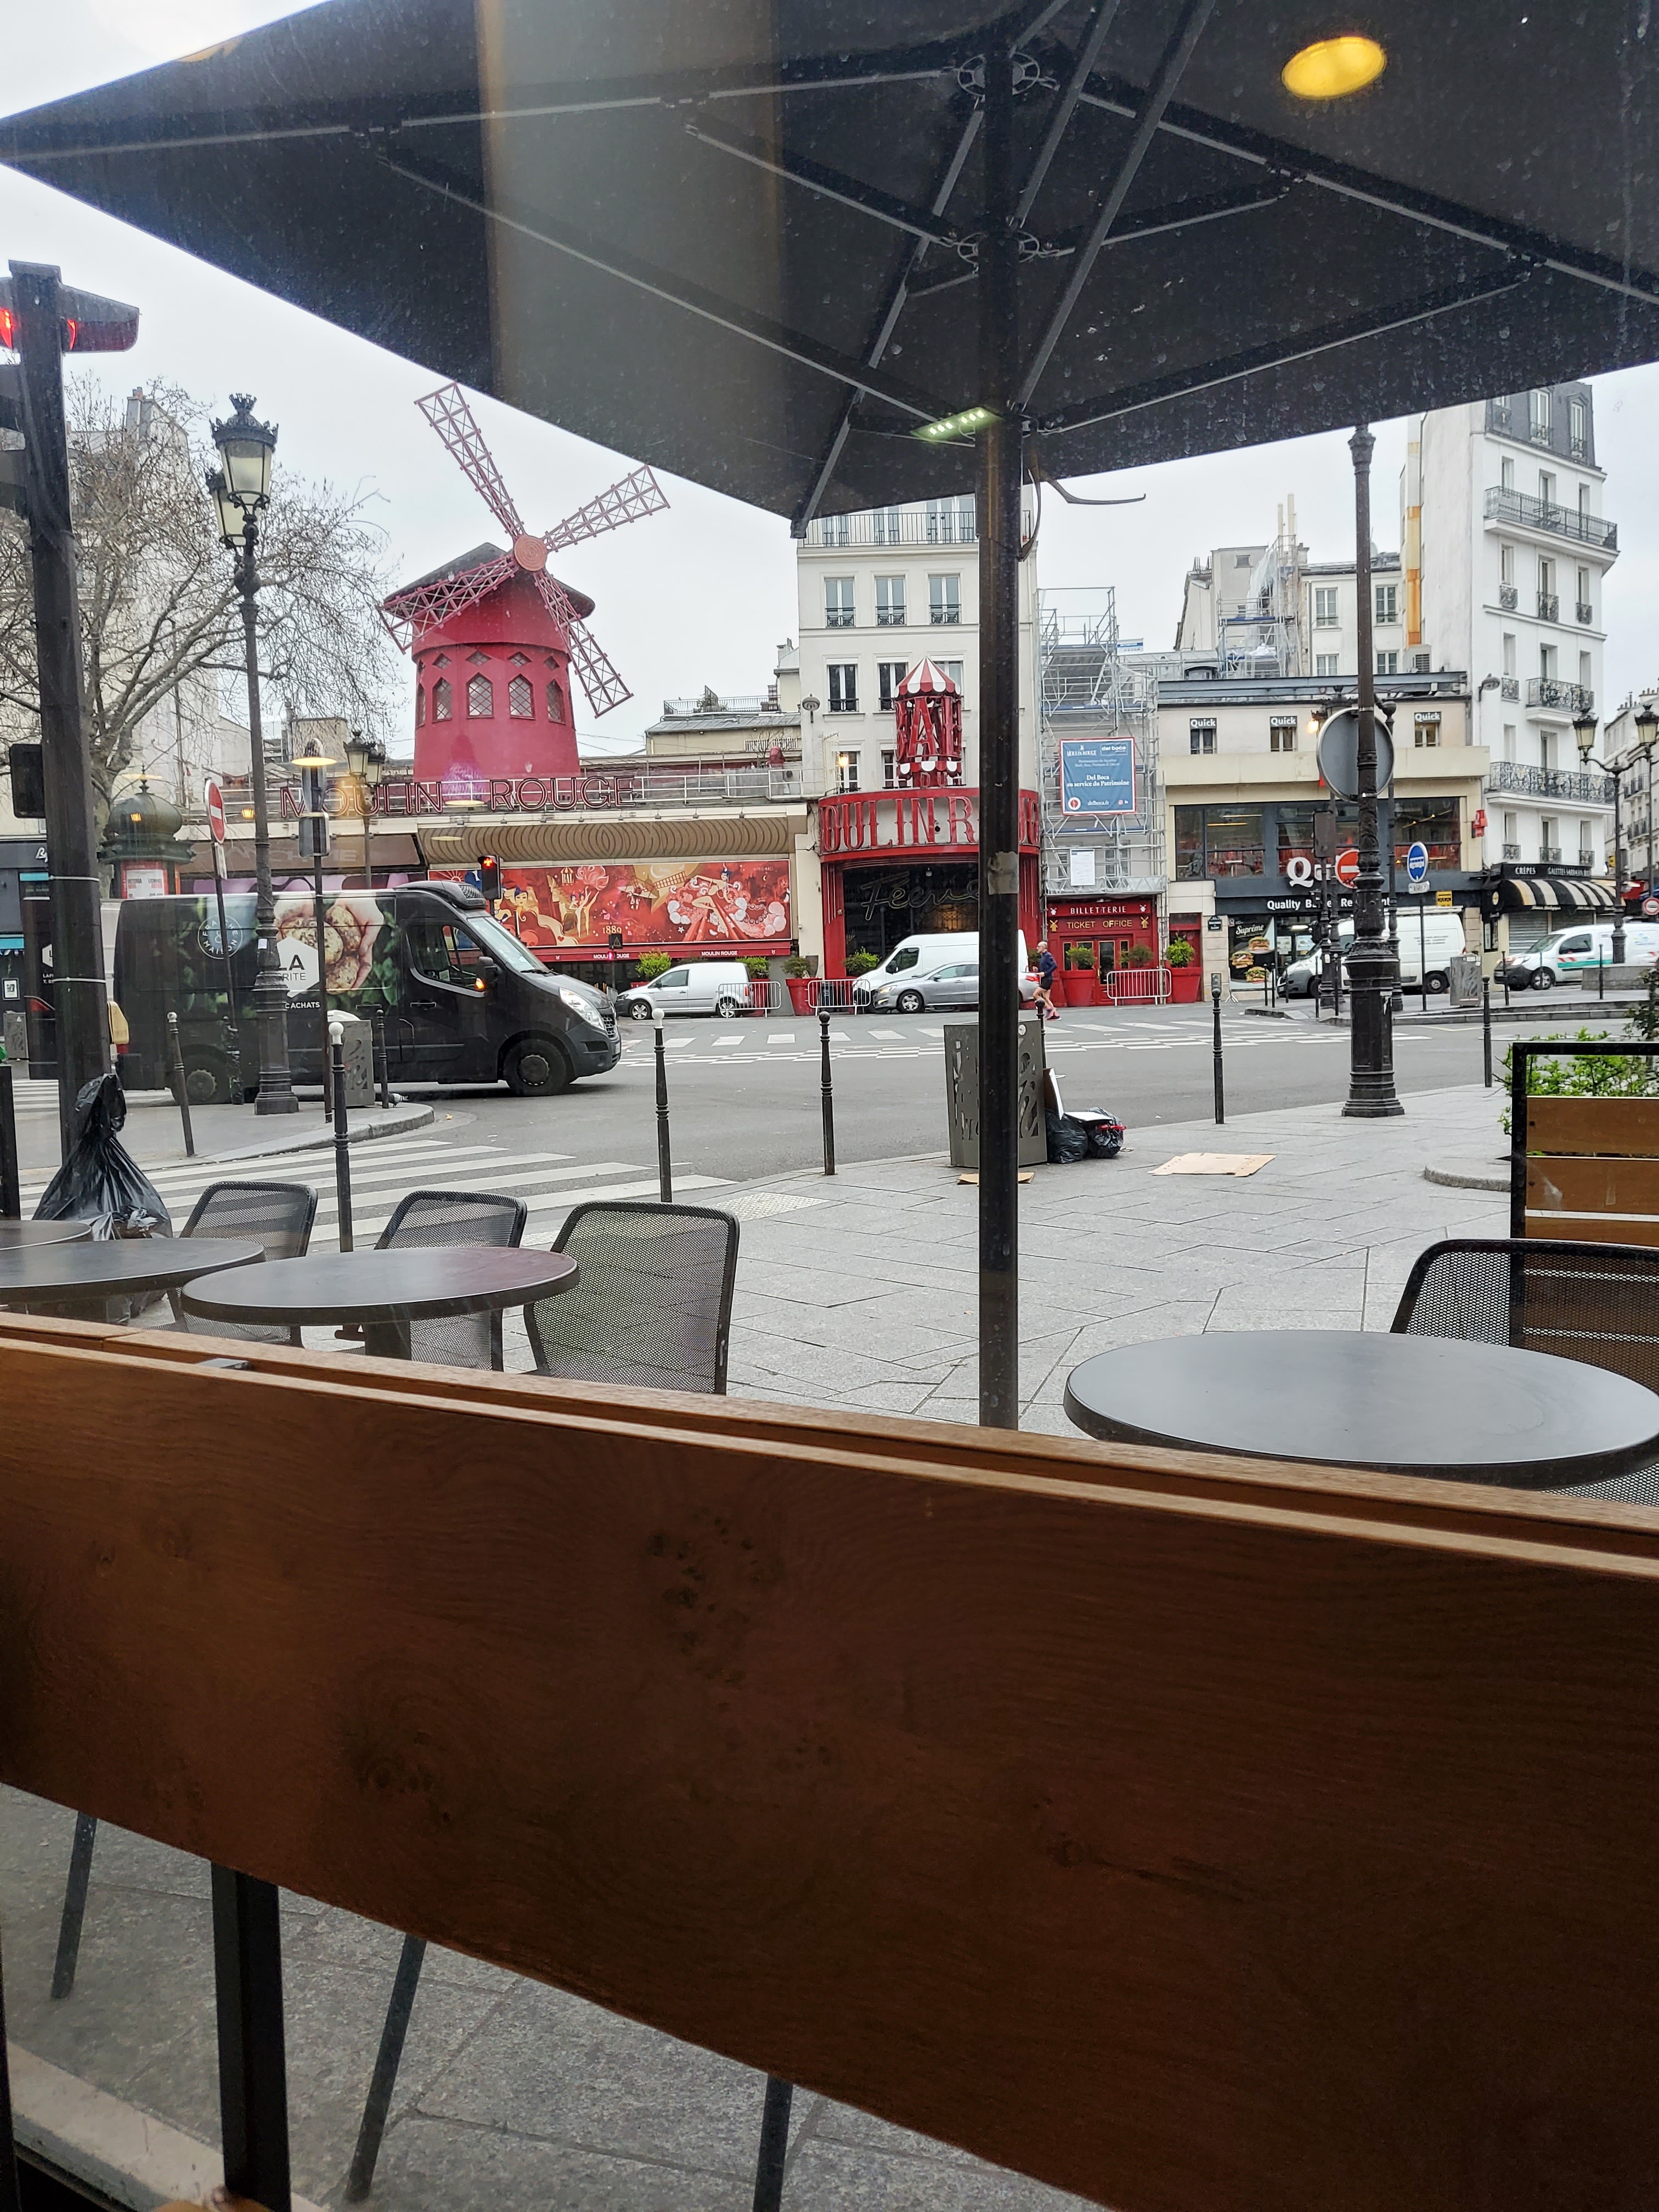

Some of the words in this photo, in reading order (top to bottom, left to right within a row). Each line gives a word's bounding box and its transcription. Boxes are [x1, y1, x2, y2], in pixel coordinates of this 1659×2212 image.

[1271, 716, 1296, 725] Quick
[1415, 712, 1441, 722] Quick
[1190, 719, 1216, 727] Quick
[920, 771, 948, 788] DU
[280, 781, 442, 818] MOULIN
[489, 776, 636, 812] ROUGE
[561, 873, 574, 884] BAL
[1267, 899, 1301, 911] Quality
[1070, 906, 1127, 915] BILLETTERIE
[1066, 921, 1096, 929] TICKET
[1102, 919, 1133, 928] OFFICE
[602, 925, 622, 934] 1889
